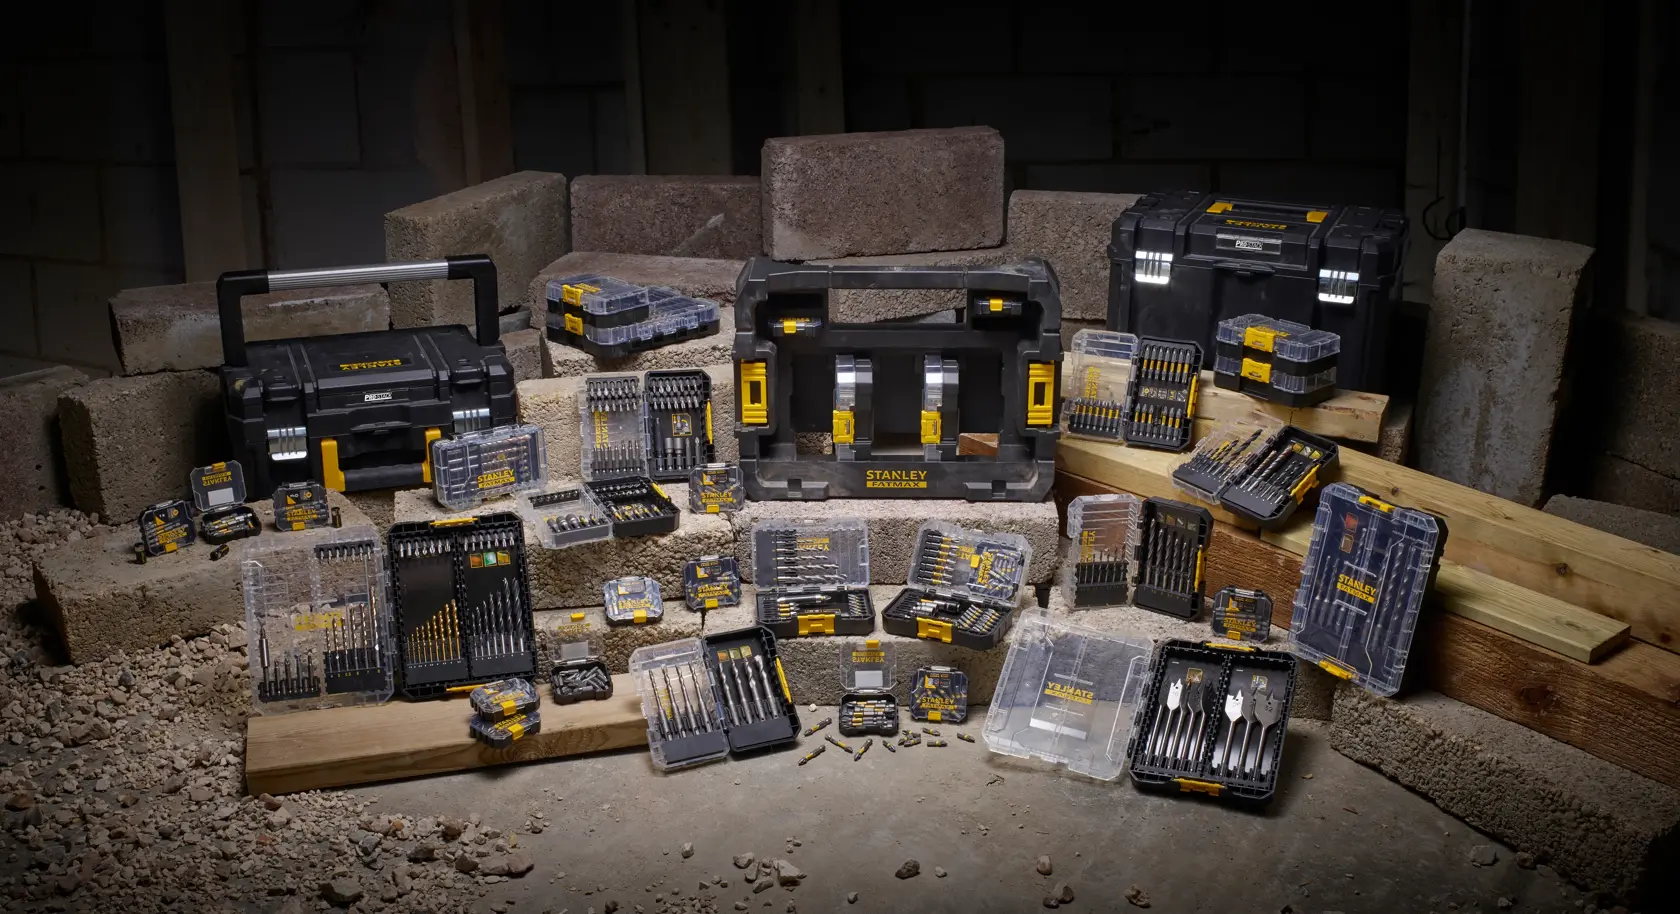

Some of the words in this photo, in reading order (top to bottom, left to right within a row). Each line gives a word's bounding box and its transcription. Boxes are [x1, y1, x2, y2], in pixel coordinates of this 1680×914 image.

[478, 468, 515, 483] STANLEY
[866, 470, 927, 480] STANLEY
[701, 491, 733, 499] STANLEY
[698, 584, 729, 593] STANLEY
[1338, 573, 1377, 596] STANLEY
[1223, 617, 1257, 627] STANLEY
[922, 696, 955, 704] STANLEY
